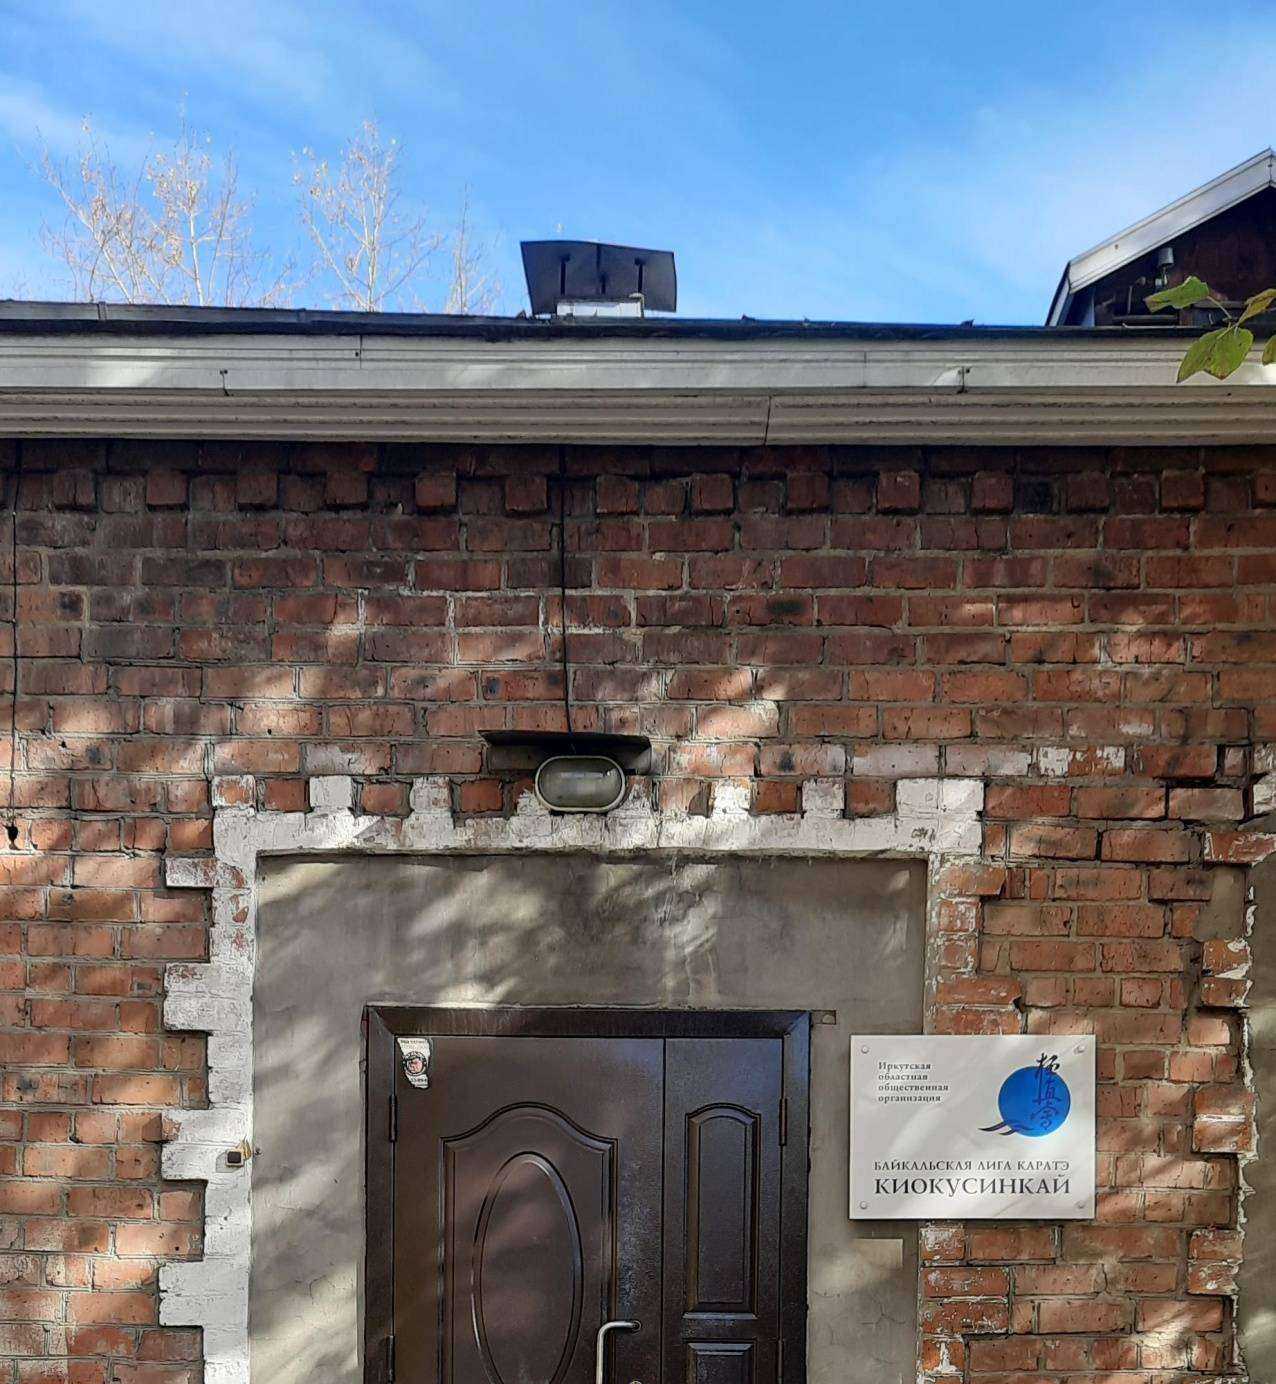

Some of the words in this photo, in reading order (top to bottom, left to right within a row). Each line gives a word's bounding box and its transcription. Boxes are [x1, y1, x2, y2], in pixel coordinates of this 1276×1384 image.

[878, 1061, 931, 1072] Иркутская
[878, 1072, 928, 1080] областная
[878, 1083, 949, 1092] общественная
[878, 1095, 941, 1104] организация
[874, 1159, 972, 1171] БАЙКАЛЬСКАЯ
[977, 1160, 1012, 1171] ЛИГА
[1017, 1160, 1070, 1171] КАРАТЭ
[874, 1173, 1070, 1197] КИОКУСИНКАЙ
